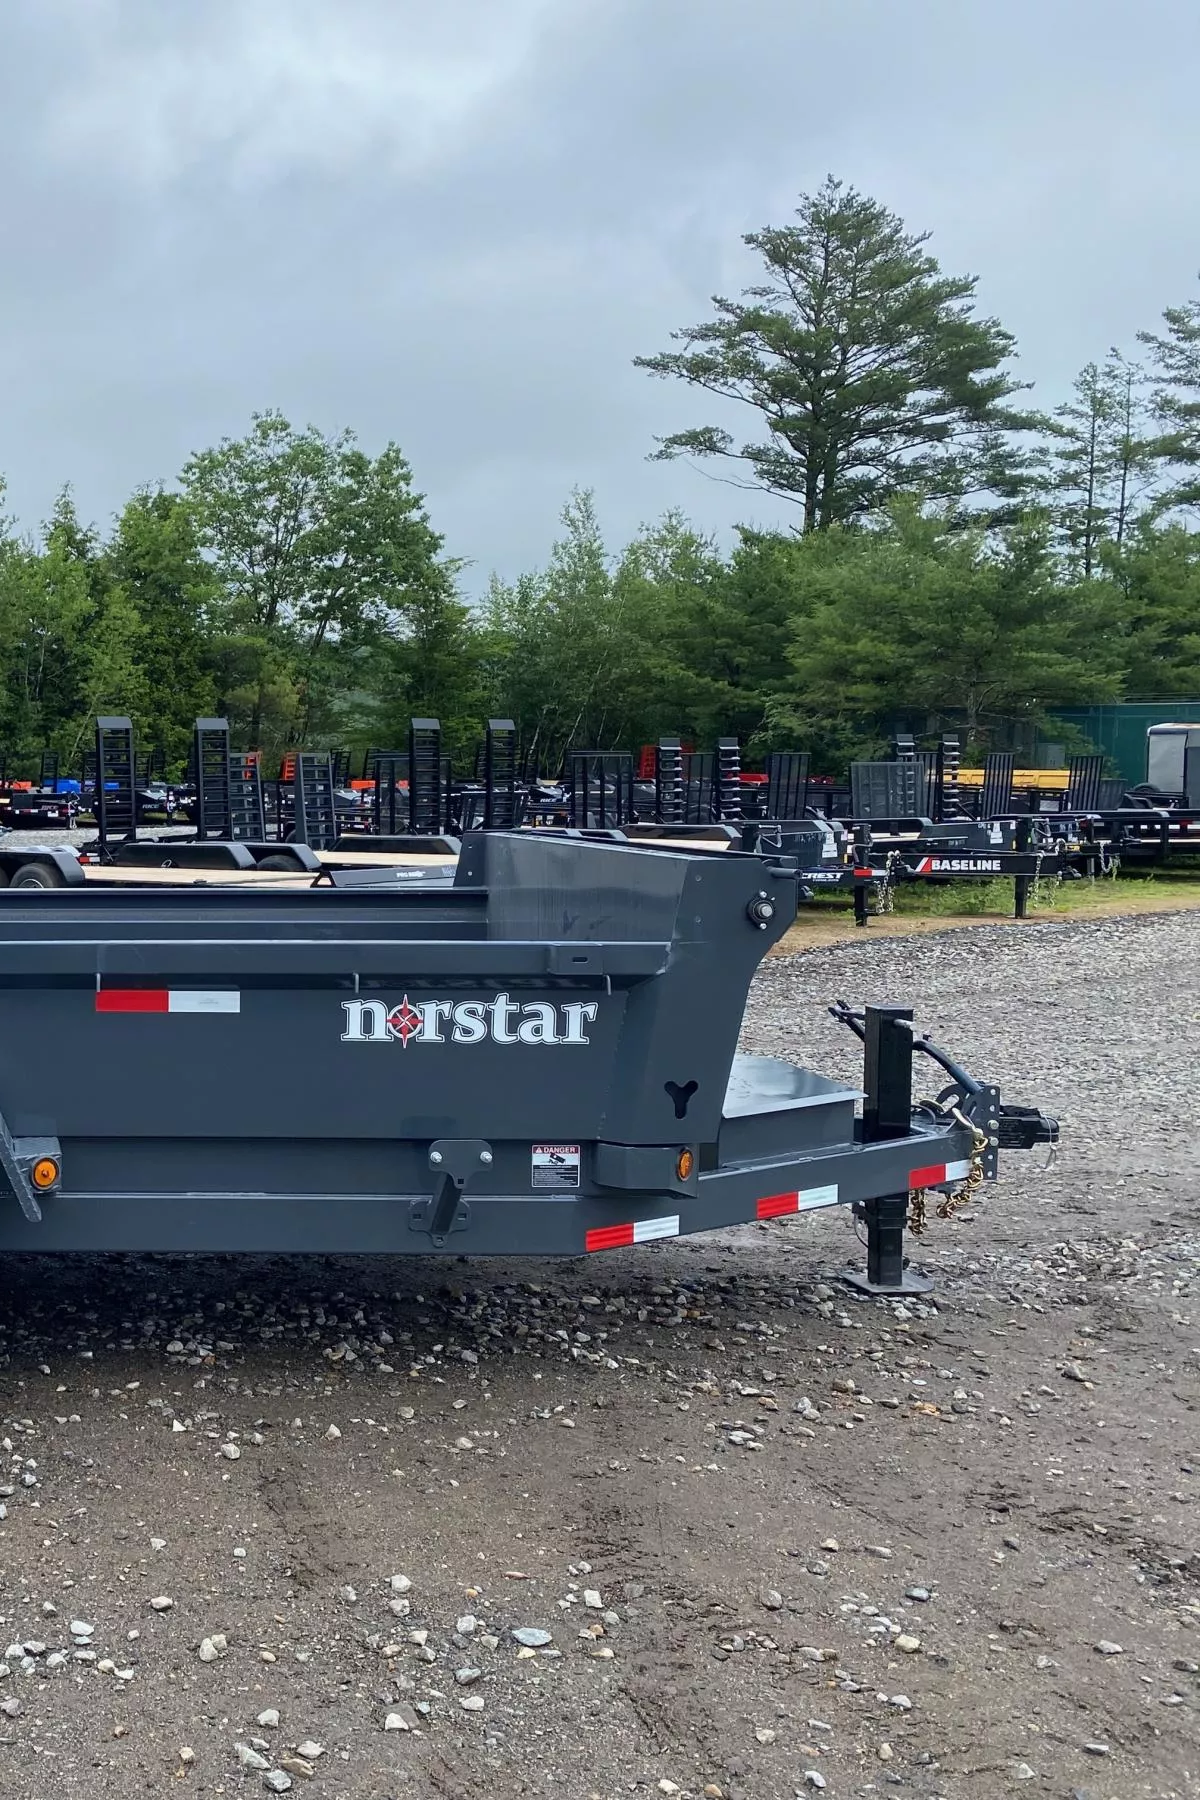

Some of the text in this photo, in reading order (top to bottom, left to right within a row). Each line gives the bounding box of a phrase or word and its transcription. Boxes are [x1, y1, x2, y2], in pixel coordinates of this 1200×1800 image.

[931, 860, 1001, 870] BASELINE
[341, 992, 599, 1046] norstar
[543, 1146, 576, 1154] DANGER
